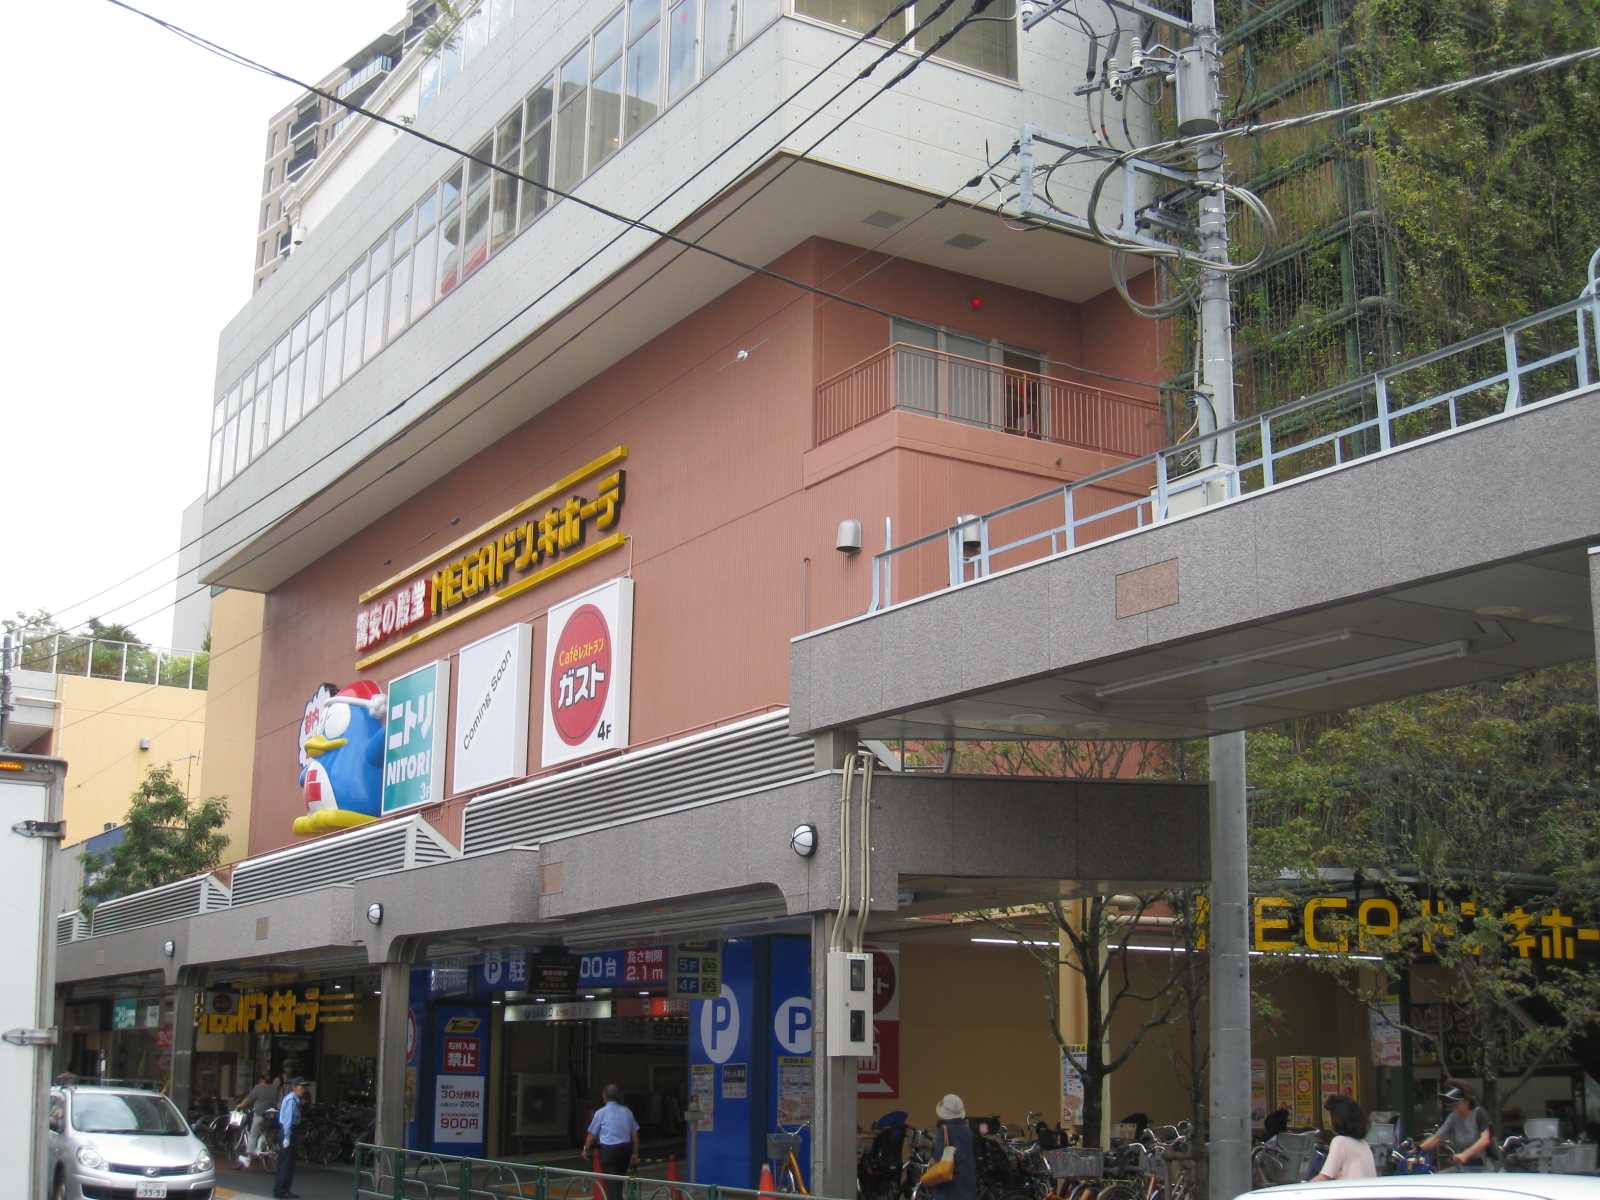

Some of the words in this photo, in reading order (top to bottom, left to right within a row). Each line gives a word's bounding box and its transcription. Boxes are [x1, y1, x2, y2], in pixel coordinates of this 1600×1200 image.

[557, 662, 605, 710] ガスト
[462, 694, 492, 751] Coming
[490, 649, 512, 688] Soon
[389, 690, 434, 750] ニトリ
[597, 720, 612, 741] 4F
[386, 747, 430, 787] NITORI
[419, 782, 431, 800] 3F
[627, 949, 663, 963] 高さ制限
[448, 1052, 475, 1068] 禁止
[440, 1090, 480, 1100] 30分無料
[440, 1117, 479, 1129] 900円
